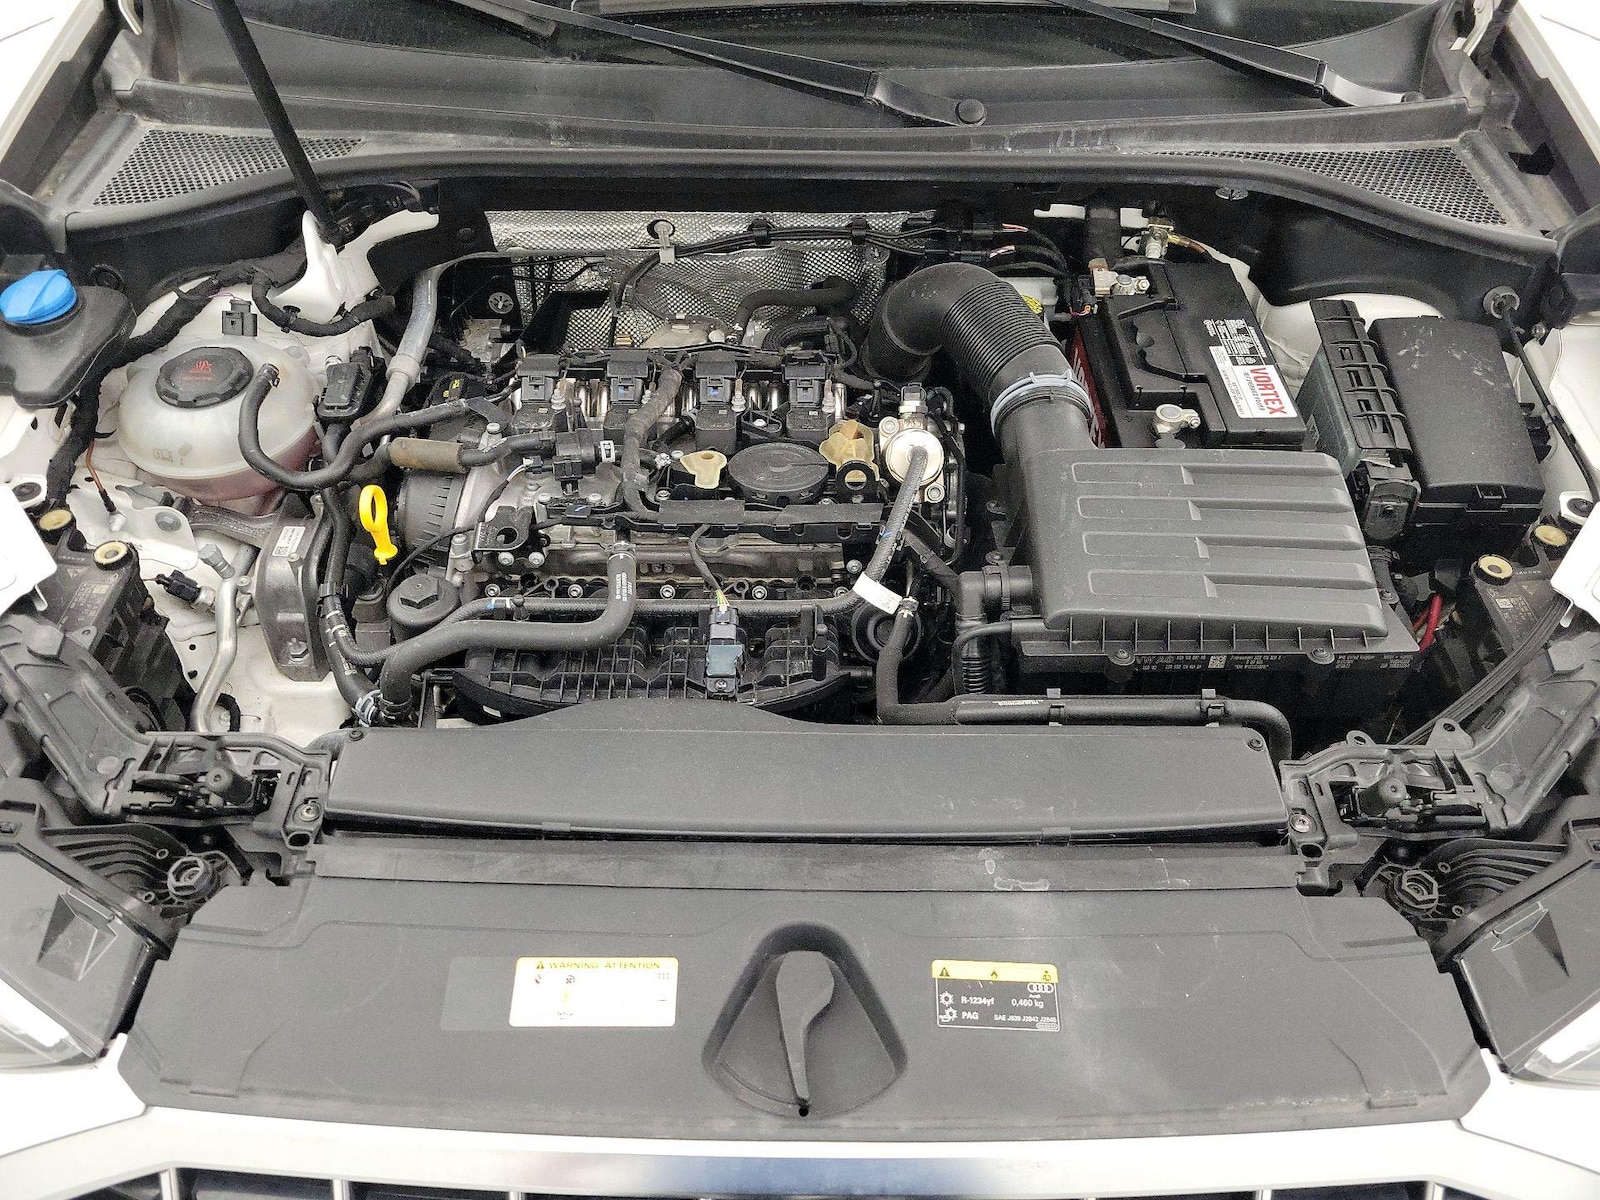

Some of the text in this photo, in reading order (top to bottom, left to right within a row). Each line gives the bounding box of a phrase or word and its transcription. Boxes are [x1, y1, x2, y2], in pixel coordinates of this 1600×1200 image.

[1249, 367, 1288, 415] VORTEX
[549, 961, 661, 970] WARNING ATTENTION
[960, 995, 995, 1007] R-1234yf
[1011, 998, 1044, 1009] 0,460 kg
[961, 1011, 979, 1020] PAG
